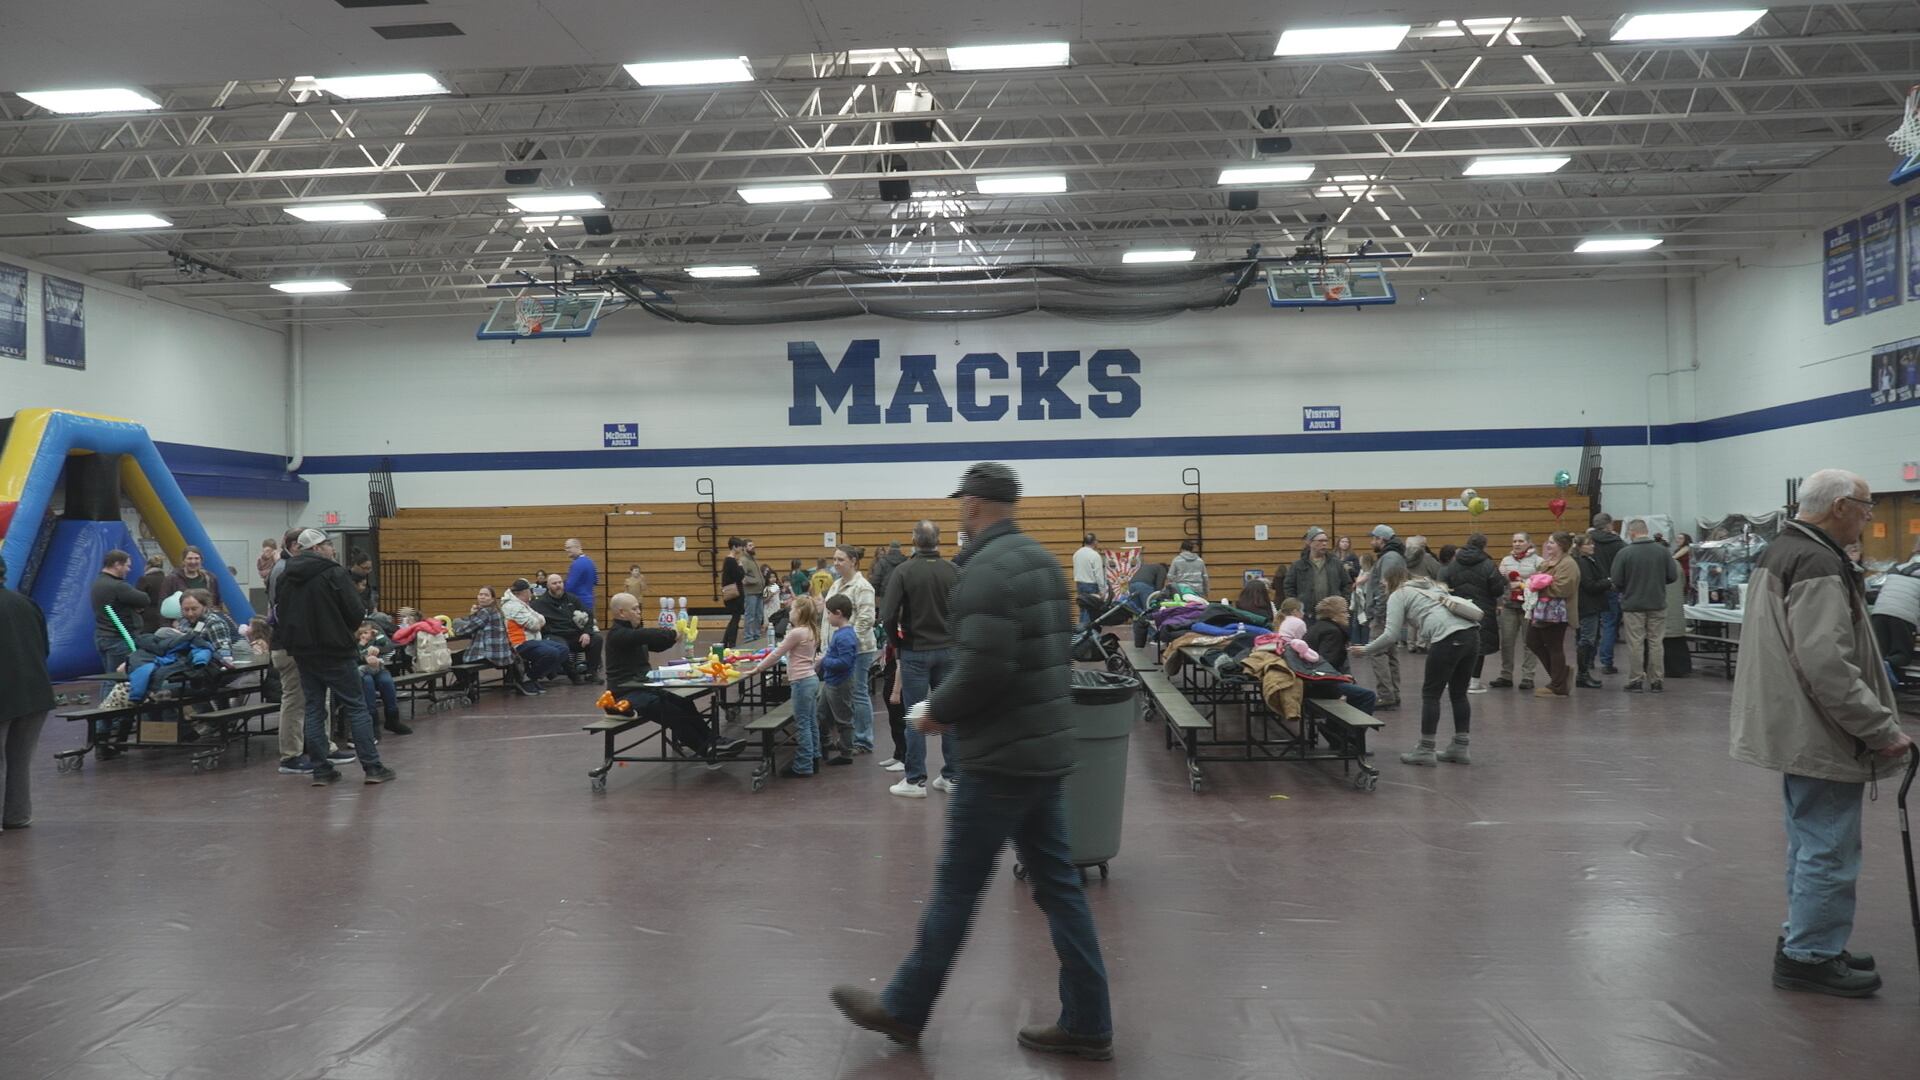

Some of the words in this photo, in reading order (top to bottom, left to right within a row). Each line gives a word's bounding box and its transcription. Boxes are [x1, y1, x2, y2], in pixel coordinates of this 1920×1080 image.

[0, 345, 18, 354] ACKS
[787, 339, 1141, 426] MACKS
[1304, 409, 1339, 418] VISITING
[1309, 421, 1335, 429] ADULTS
